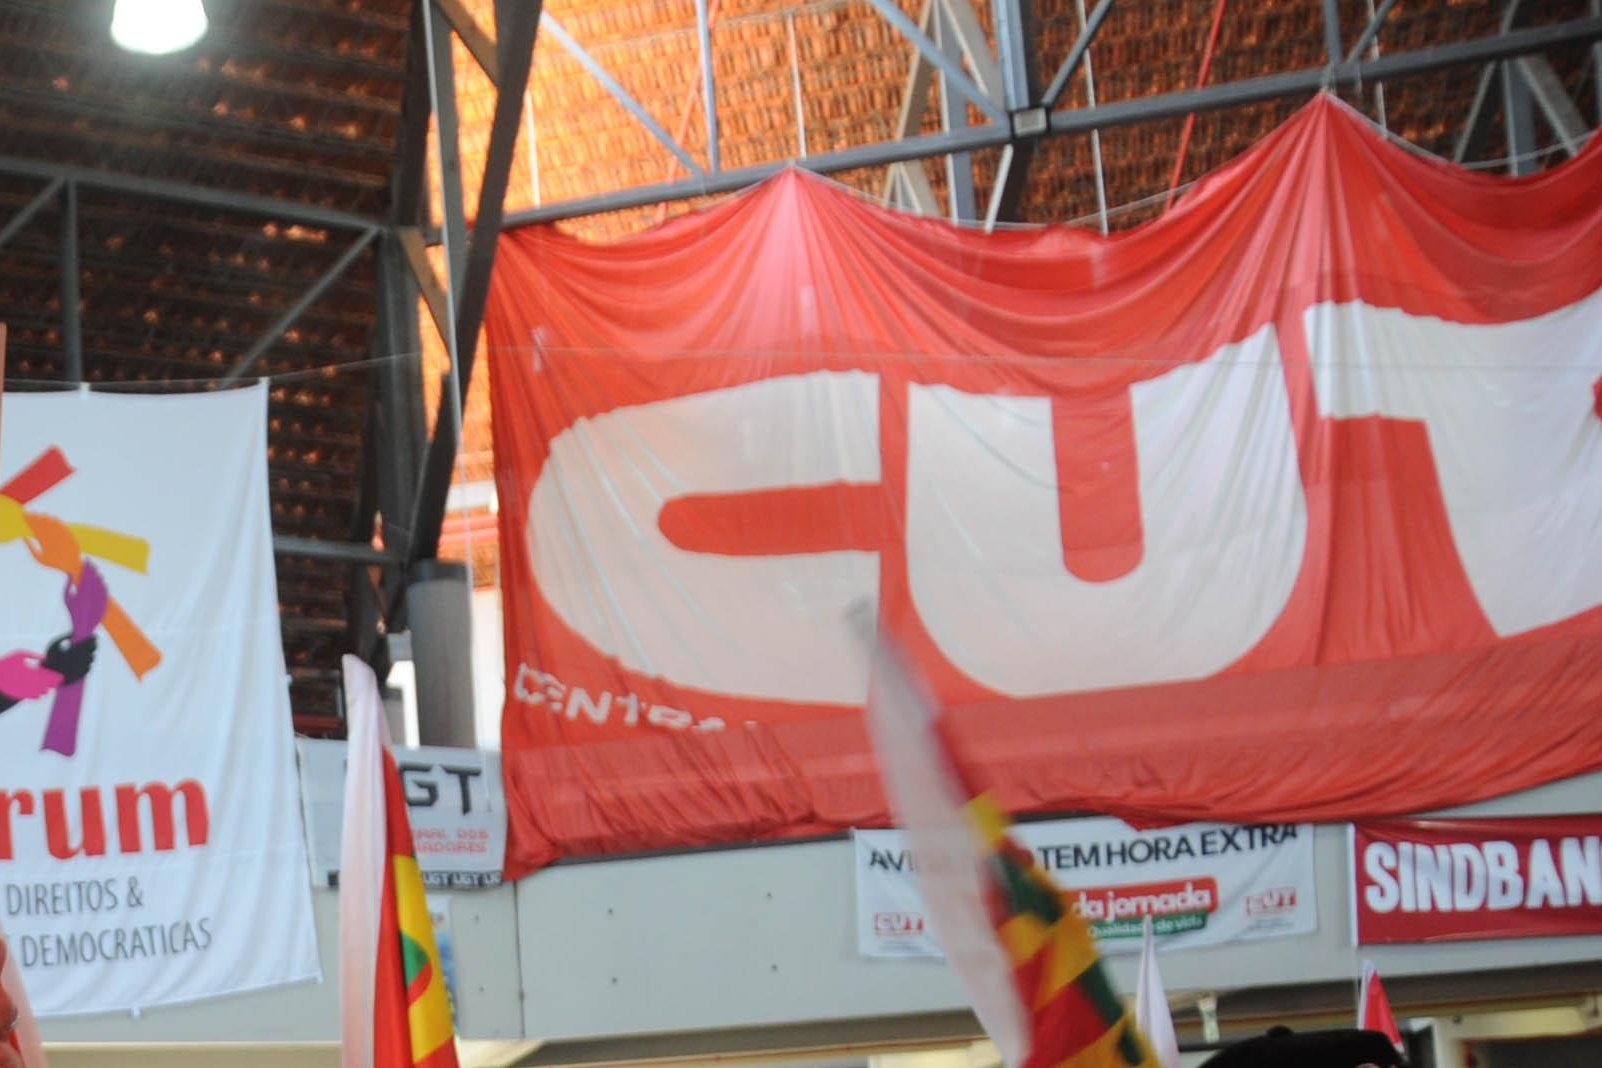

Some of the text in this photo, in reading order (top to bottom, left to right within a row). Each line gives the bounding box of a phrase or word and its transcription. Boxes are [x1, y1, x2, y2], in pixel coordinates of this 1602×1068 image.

[526, 284, 1602, 704] CUT
[399, 760, 481, 816] GT
[1038, 843, 1101, 871] TEM
[1106, 834, 1194, 866] HORA
[1200, 822, 1298, 856] EXTRA
[5, 877, 119, 917] DIREITOS
[126, 875, 145, 909] &
[21, 917, 212, 967] DEMOCRATICAS
